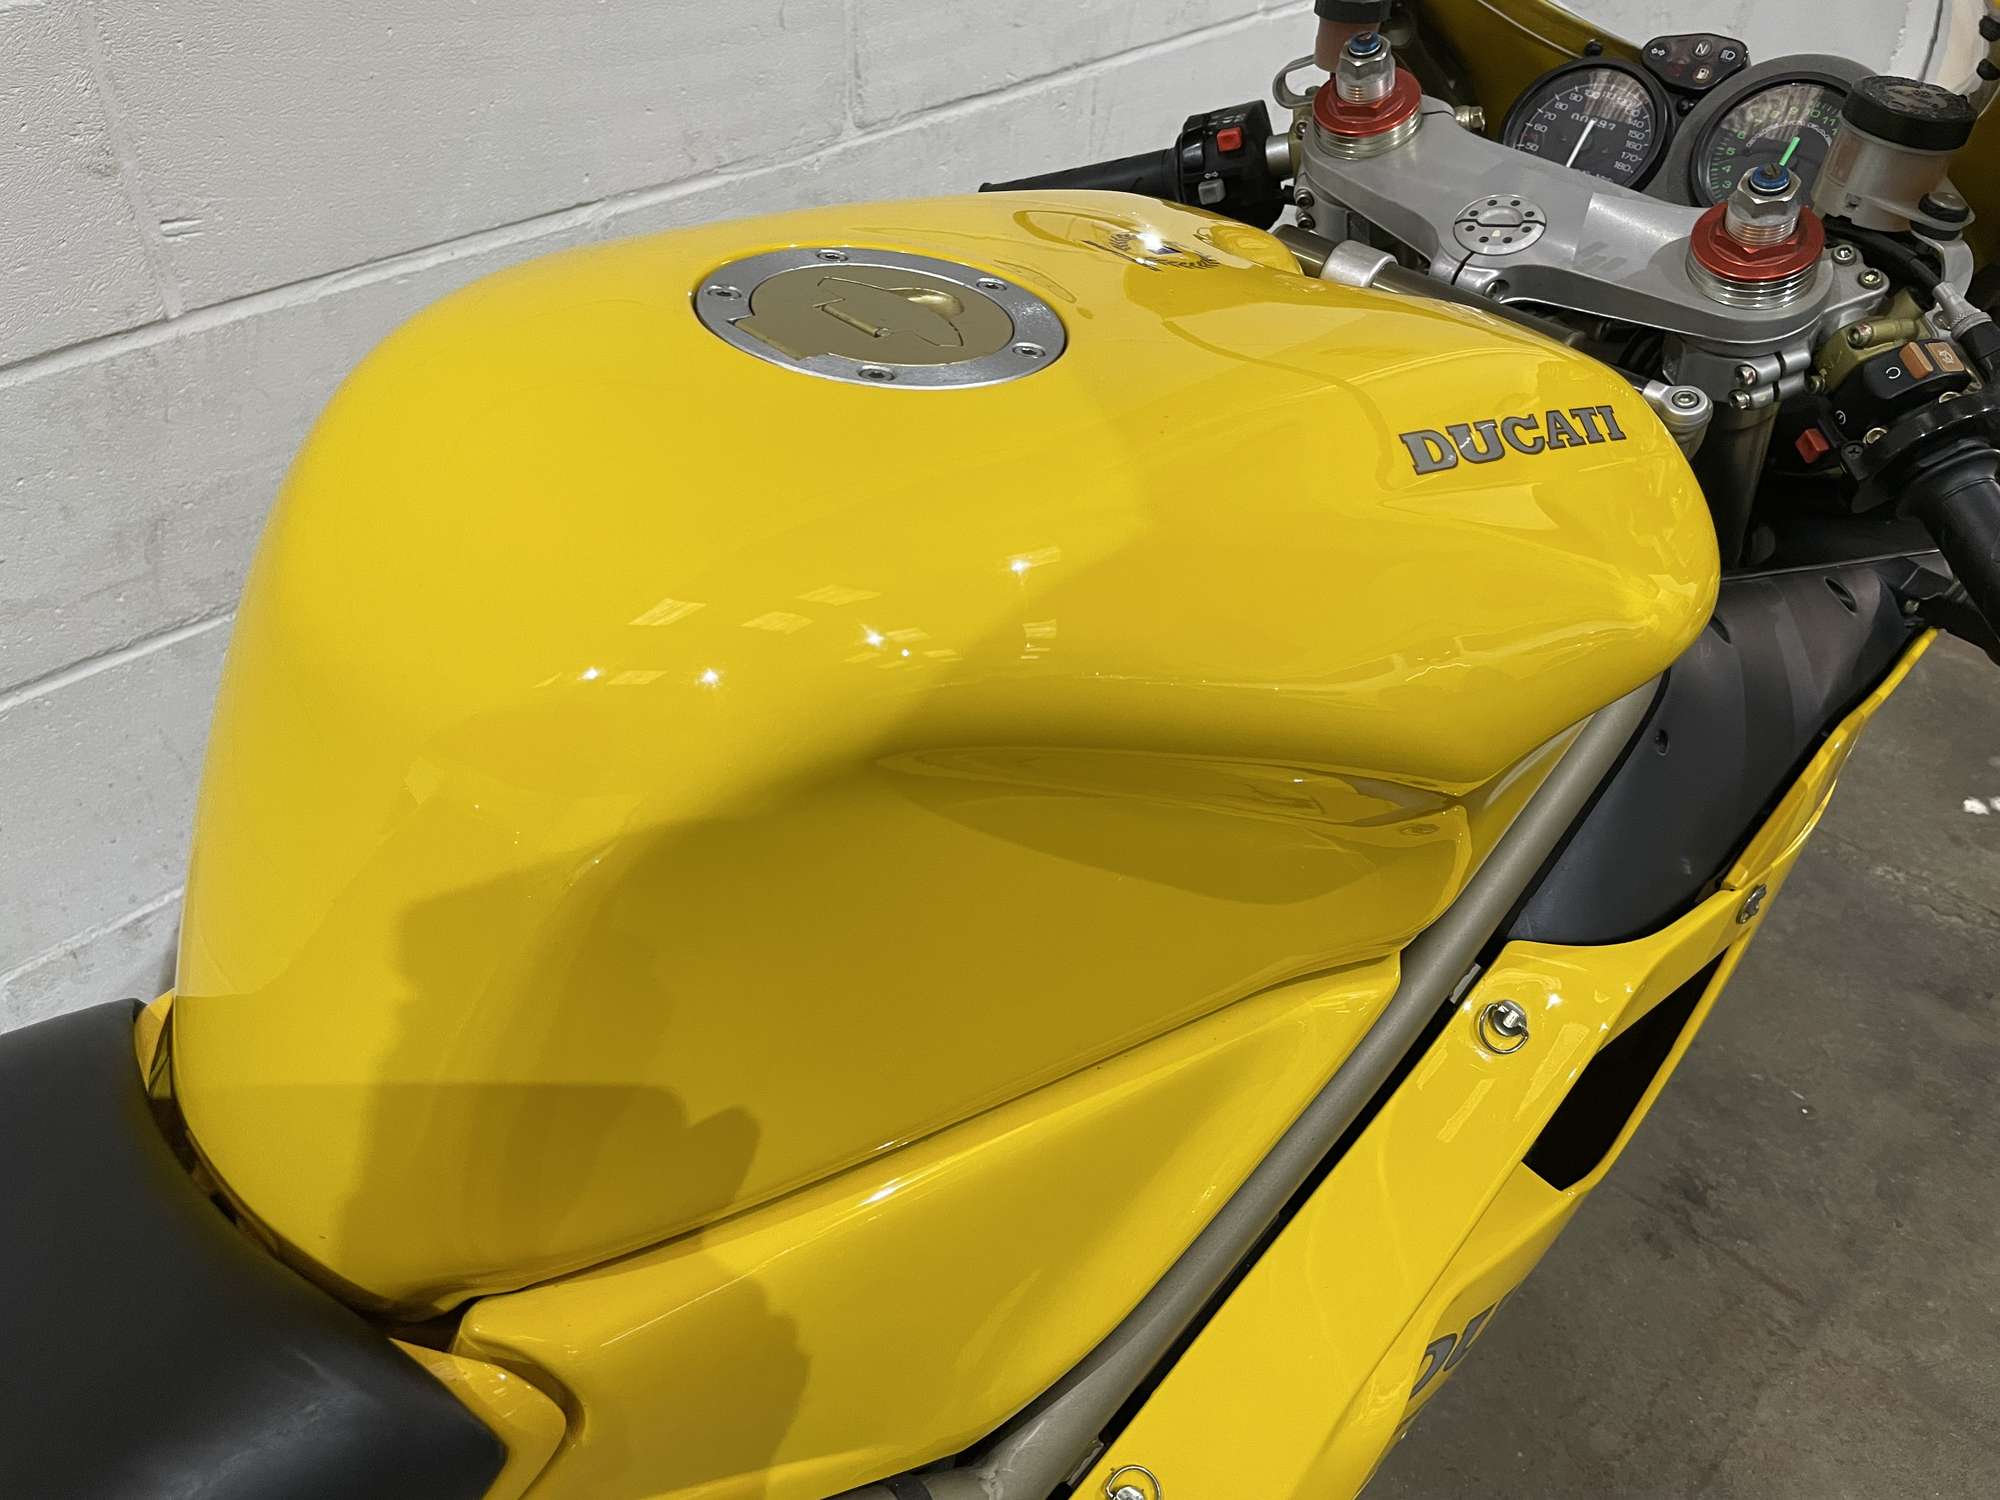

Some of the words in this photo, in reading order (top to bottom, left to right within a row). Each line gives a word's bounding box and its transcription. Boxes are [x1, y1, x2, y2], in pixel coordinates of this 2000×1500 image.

[1695, 43, 1708, 56] N
[1569, 92, 1583, 103] 90
[1554, 101, 1568, 111] 80
[1543, 112, 1557, 121] 70
[1533, 123, 1548, 134] 60
[1628, 128, 1645, 140] 150
[1736, 131, 1746, 140] 6
[1525, 142, 1540, 151] 50
[1625, 139, 1642, 151] 160
[1726, 146, 1736, 156] 5
[1620, 151, 1638, 162] 170
[1721, 165, 1732, 174] 4
[1722, 180, 1732, 190] 3
[1399, 405, 1627, 475] DUCATI
